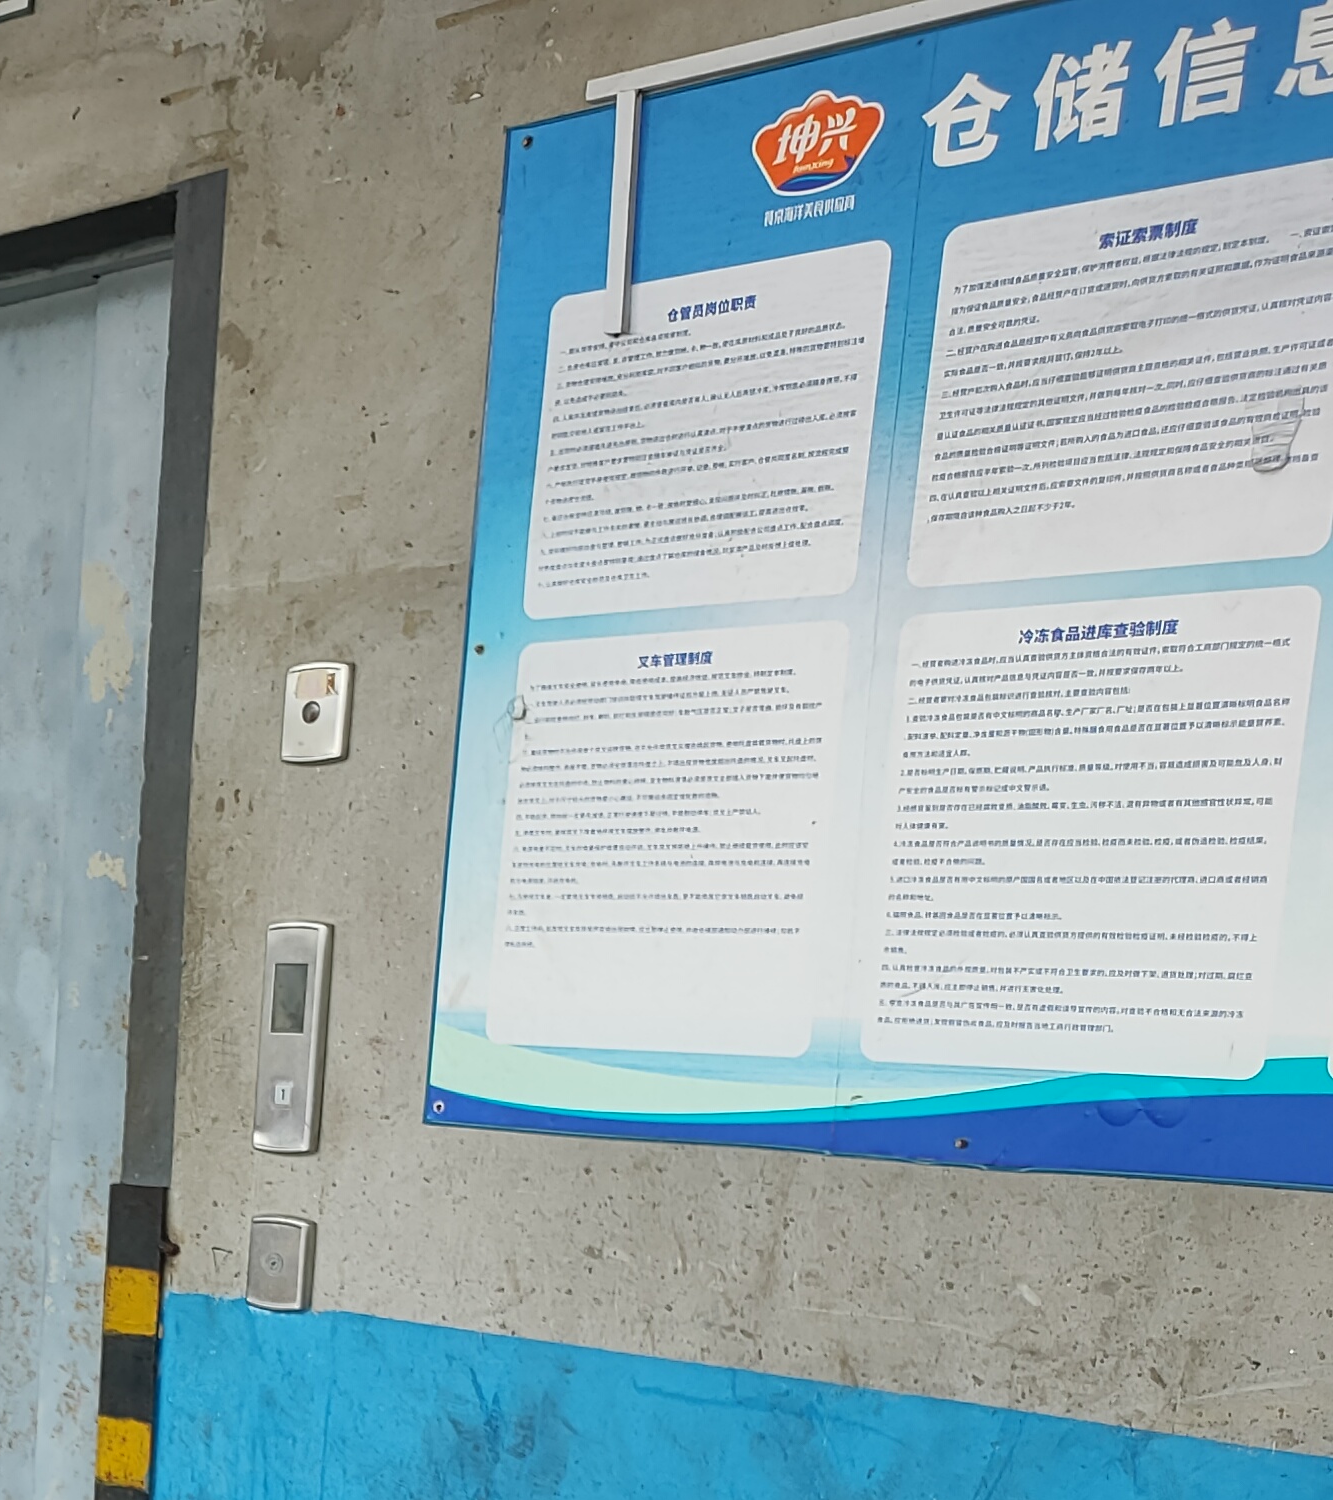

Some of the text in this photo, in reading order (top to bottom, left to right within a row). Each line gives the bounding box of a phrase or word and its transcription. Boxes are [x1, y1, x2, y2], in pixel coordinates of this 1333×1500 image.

[772, 107, 858, 166] 坤兴
[1097, 218, 1199, 250] 索证索票制度
[667, 294, 758, 323] 仓管员岗位职责
[1018, 618, 1180, 645] 冷冻食品进库查验制度
[637, 650, 713, 670] 叉车管理制度
